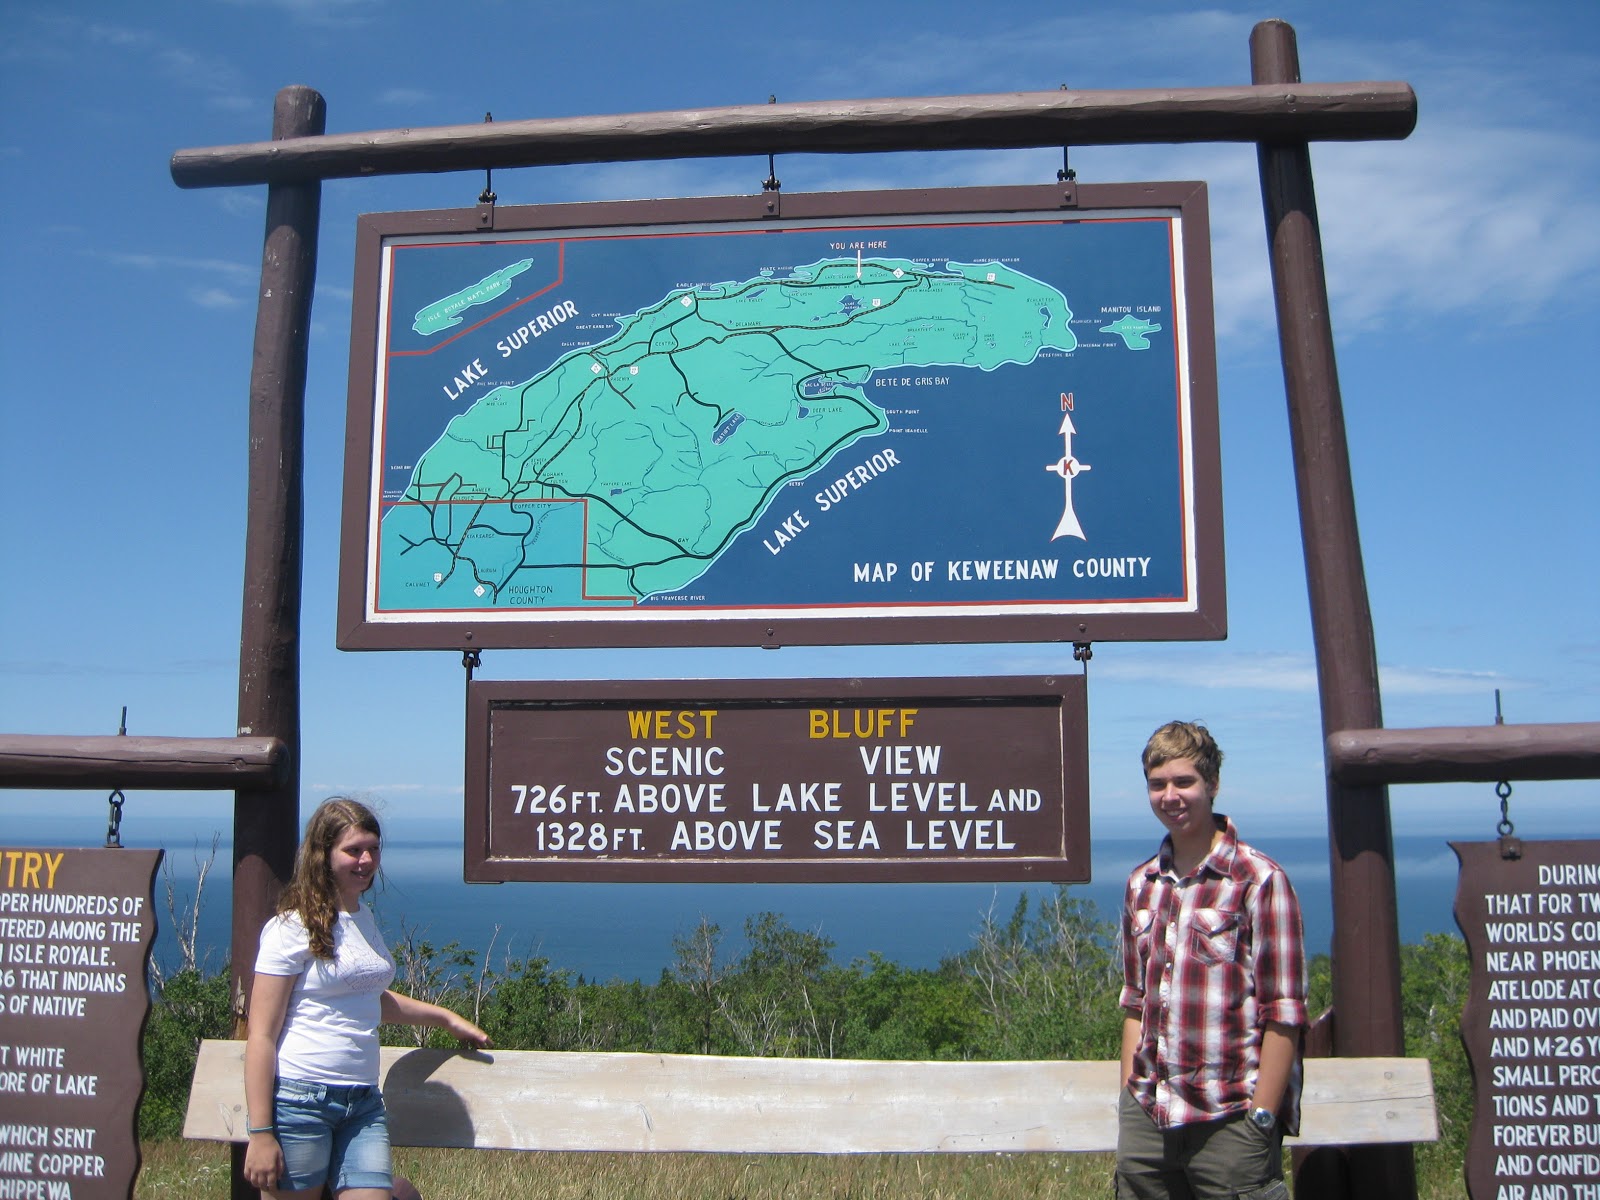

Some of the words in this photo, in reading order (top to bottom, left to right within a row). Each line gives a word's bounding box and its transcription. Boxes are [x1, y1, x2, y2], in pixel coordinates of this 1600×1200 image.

[830, 242, 846, 250] YOU
[850, 241, 865, 249] ARE
[868, 240, 888, 249] HERE
[427, 312, 441, 323] ISLE
[486, 280, 501, 292] PARK
[1136, 305, 1162, 313] ISLAND
[442, 358, 489, 401] LAKE
[496, 300, 580, 358] SUPERIOR
[875, 378, 898, 387] BETE
[901, 378, 911, 386] DE
[915, 377, 933, 386] GRIS
[934, 376, 950, 385] BAY
[1060, 392, 1074, 412] N
[1063, 459, 1074, 475] K
[762, 509, 810, 556] LAKE
[815, 448, 901, 512] SUPERIOR
[853, 563, 898, 583] MAP
[911, 561, 935, 582] OF
[948, 559, 1059, 581] KEWEENAW
[1072, 557, 1152, 578] COUNTY
[508, 585, 553, 594] HOUGHTON
[509, 596, 546, 605] COUNTY
[628, 710, 718, 739] WEST
[809, 709, 919, 739] BLUFF
[604, 747, 725, 776] SCENIC
[859, 745, 941, 775] VIEW
[613, 784, 727, 813] ABOVE
[752, 783, 842, 813] LAKE
[869, 782, 978, 812] LEVEL
[987, 788, 1042, 812] AND
[670, 820, 783, 850] ABOVE
[813, 820, 881, 850] SEA
[906, 820, 1017, 850] LEVEL
[0, 851, 64, 888] TRY
[1538, 864, 1600, 886] DURIN
[32, 893, 119, 915] HUNDREDS
[122, 897, 144, 916] OF
[1485, 893, 1532, 915] THAT
[1538, 893, 1573, 914] FOR
[0, 918, 46, 938] TERED
[48, 920, 106, 940] AMONG
[111, 922, 142, 942] THE
[1485, 921, 1565, 943] WORLD'S
[1571, 921, 1600, 942] CO
[8, 943, 46, 964] ISLE
[49, 945, 116, 966] ROYALE.
[1486, 951, 1536, 972] NEAR
[1542, 950, 1600, 971] PHOEN
[20, 970, 58, 990] THAT
[62, 971, 127, 993] INDIANS
[1568, 979, 1591, 999] AT
[9, 995, 30, 1014] OF
[32, 996, 87, 1017] NATIVE
[1489, 1008, 1527, 1029] AND
[1530, 1007, 1569, 1029] PAID
[1573, 1007, 1600, 1028] OV
[15, 1046, 65, 1068] WHITE
[1490, 1037, 1529, 1058] AND
[1586, 1036, 1600, 1057] Y
[31, 1073, 52, 1093] OF
[55, 1074, 98, 1096] LAKE
[1492, 1065, 1555, 1087] SMALL
[1559, 1065, 1600, 1086] PERC
[1492, 1095, 1547, 1117] TIONS
[1551, 1095, 1590, 1116] AND
[0, 1125, 49, 1146] WHICH
[52, 1127, 96, 1149] SENT
[1493, 1124, 1572, 1147] FOREVER
[1573, 1124, 1600, 1146] BU
[38, 1153, 105, 1177] COPPER
[1495, 1154, 1533, 1176] AND
[1497, 1184, 1526, 1200] AIR
[1530, 1184, 1569, 1200] AND
[1572, 1184, 1600, 1200] TH
